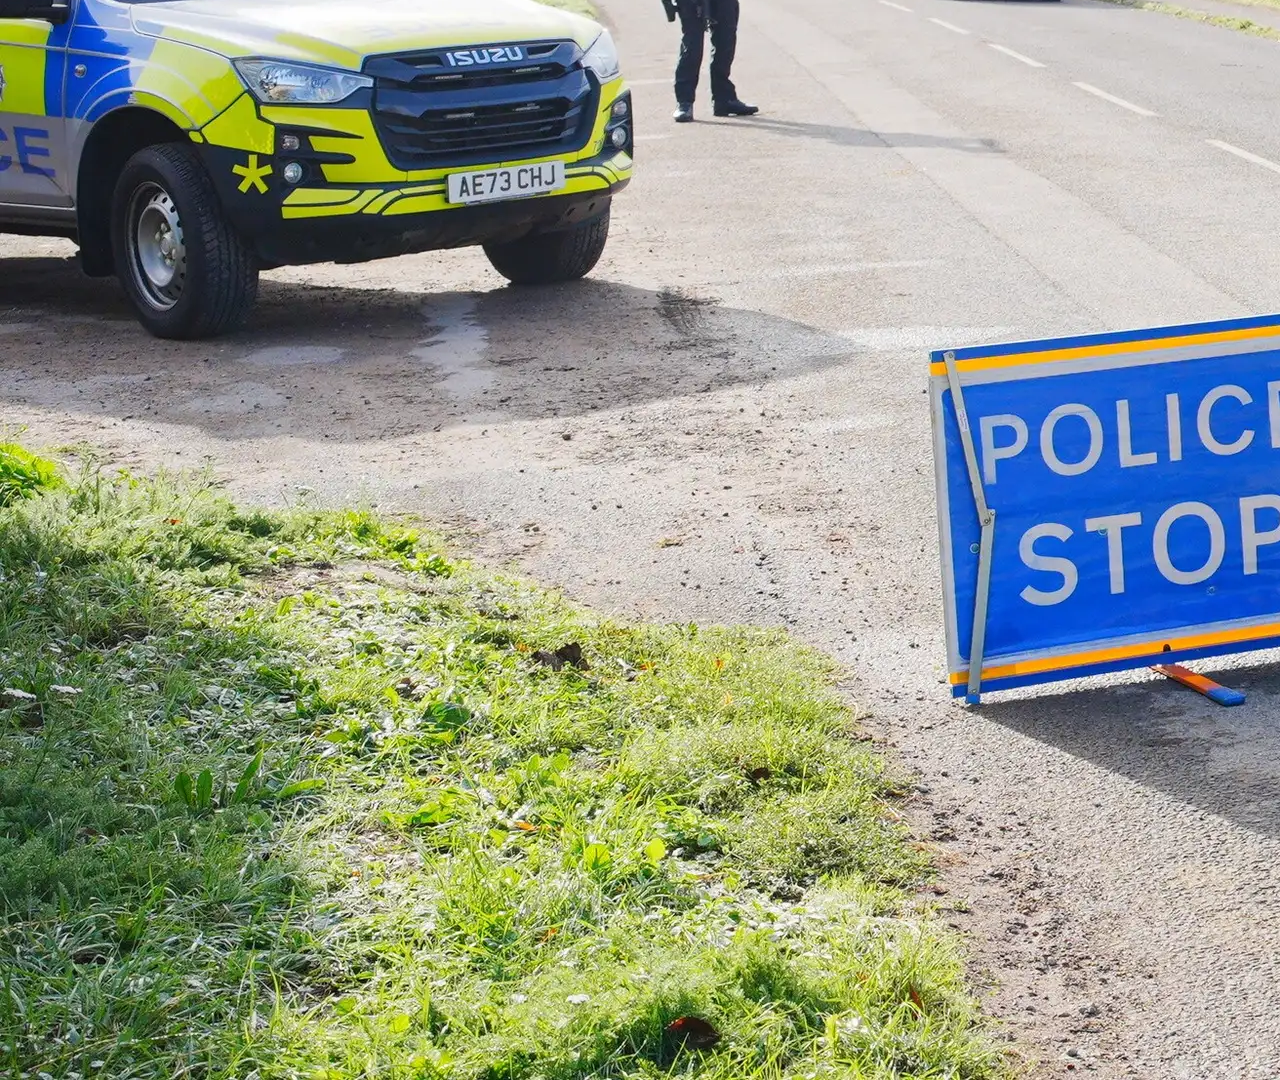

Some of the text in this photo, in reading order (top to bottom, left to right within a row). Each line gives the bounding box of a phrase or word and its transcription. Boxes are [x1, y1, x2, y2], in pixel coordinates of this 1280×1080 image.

[446, 47, 523, 67] ISUZU
[459, 165, 555, 197] AE73 CHJ
